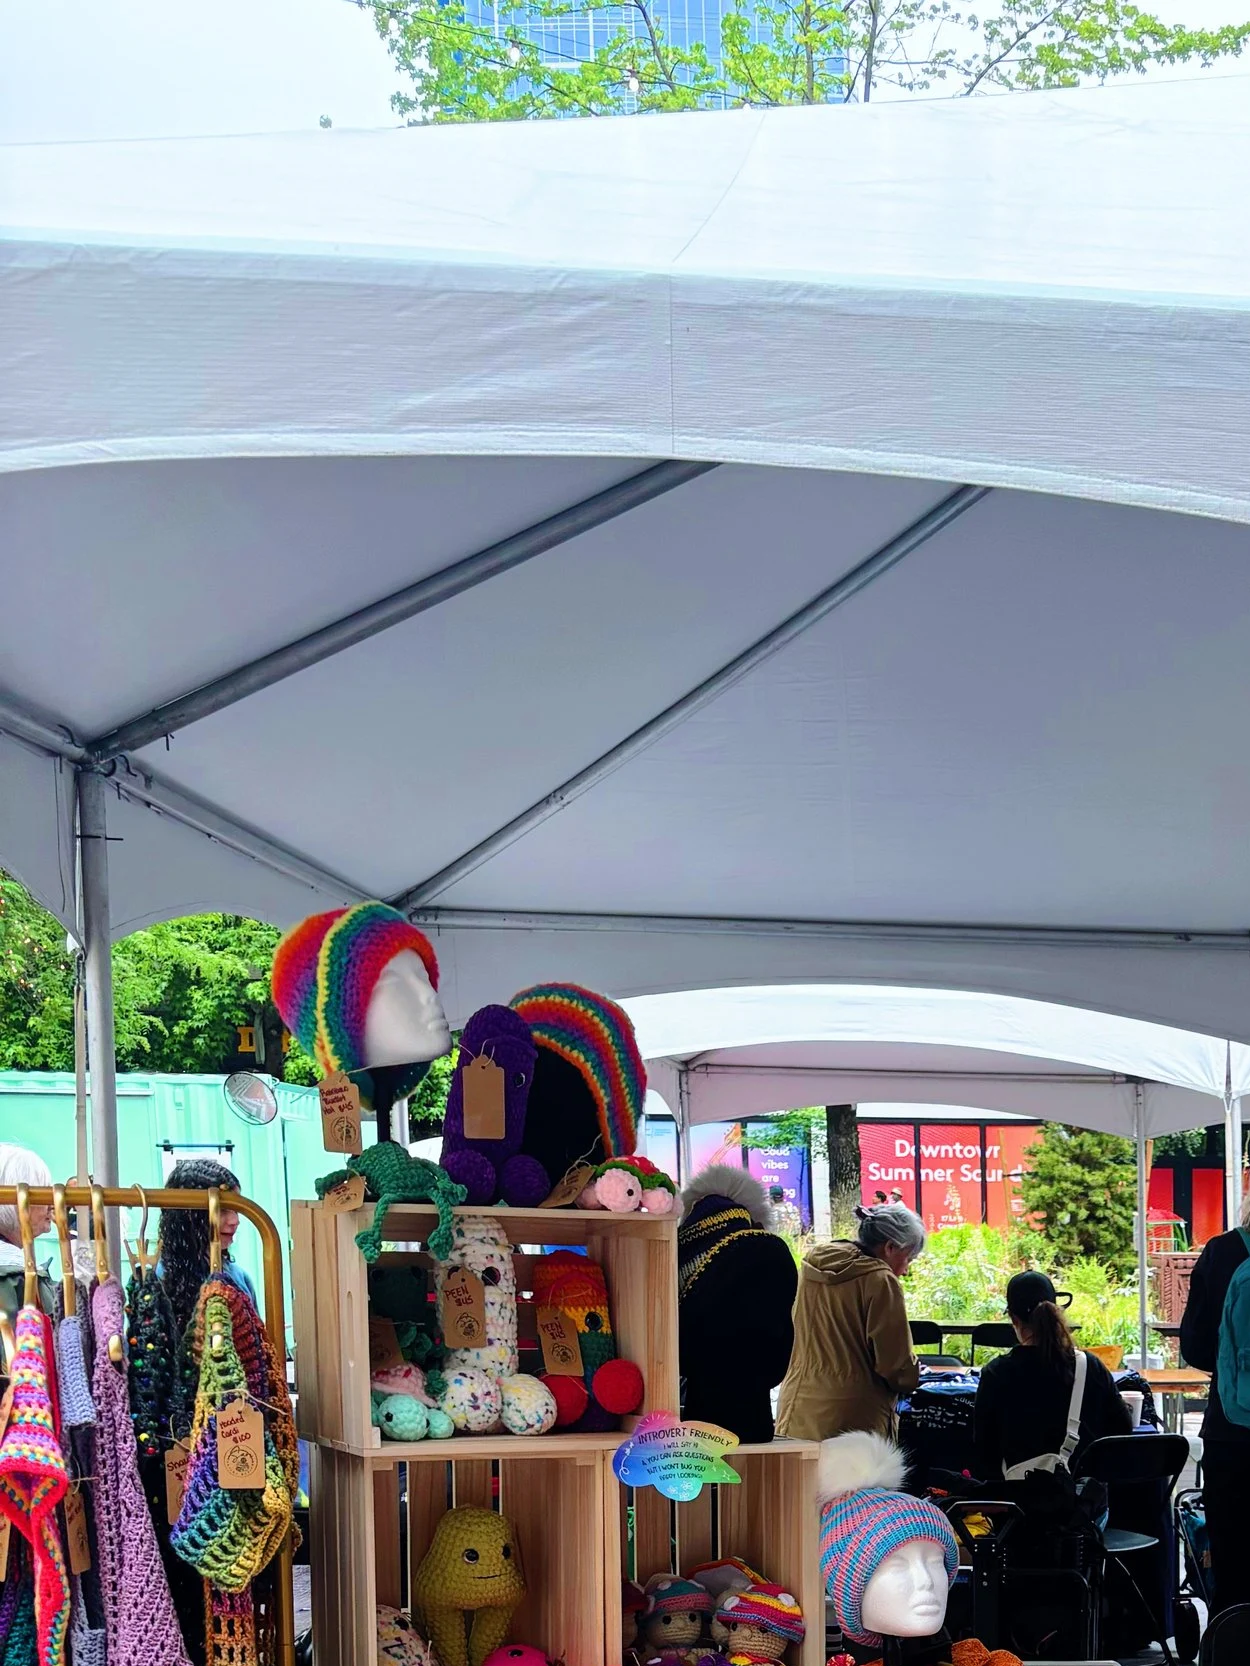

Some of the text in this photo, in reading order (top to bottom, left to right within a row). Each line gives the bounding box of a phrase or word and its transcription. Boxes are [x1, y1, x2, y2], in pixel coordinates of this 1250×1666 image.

[761, 1159, 789, 1169] vibes
[761, 1175, 779, 1183] are
[638, 1427, 733, 1447] INTROVERT FRIENDLY
[647, 1456, 659, 1464] YOU
[684, 1451, 714, 1463] QUESTIONS
[647, 1467, 658, 1475] BUT
